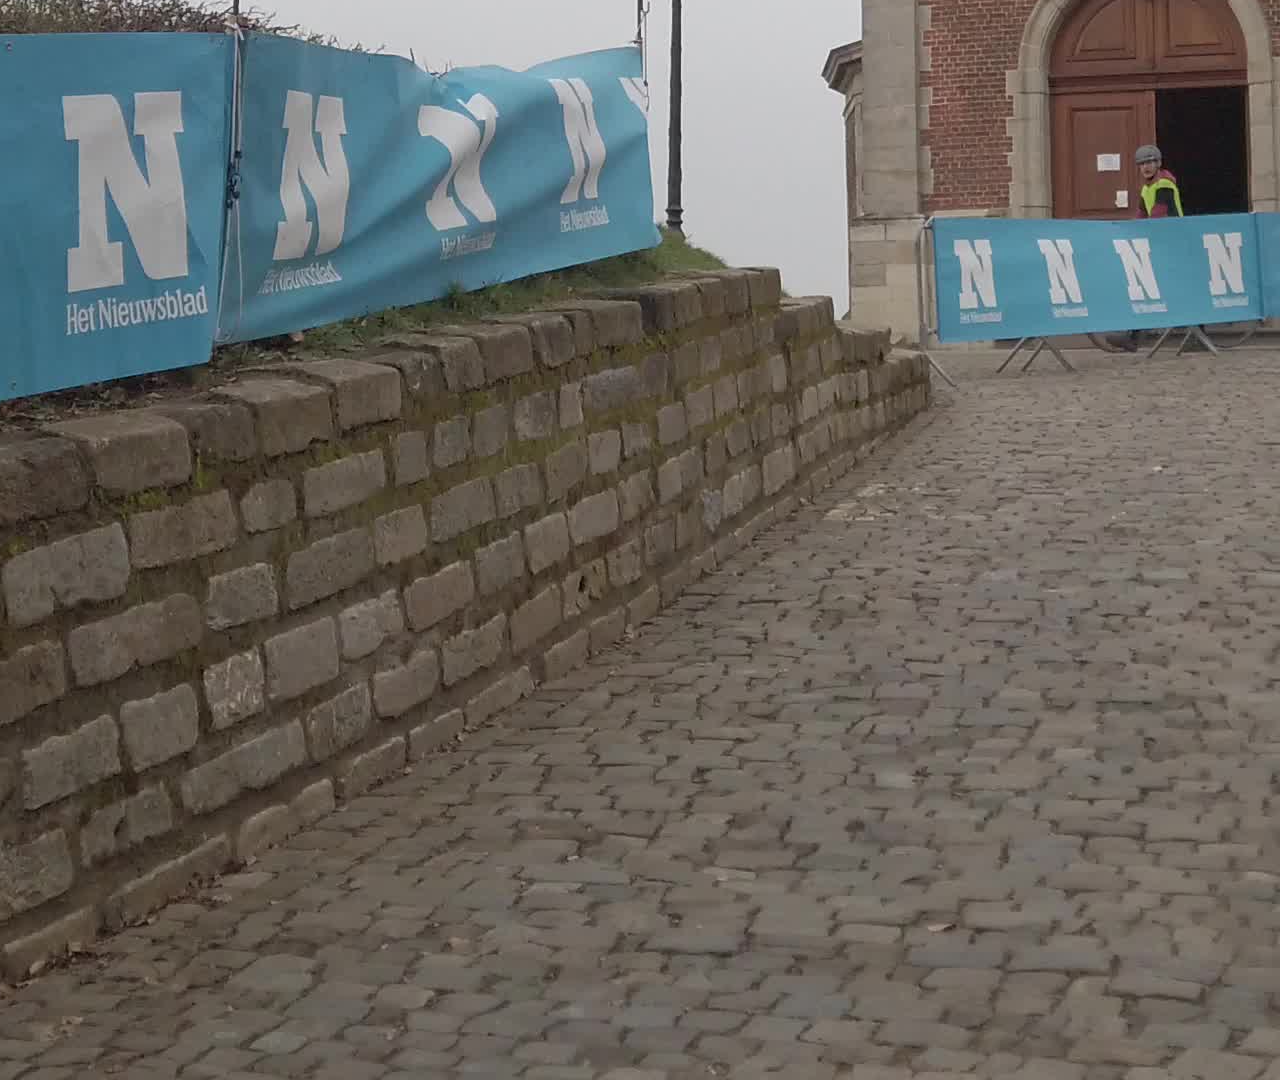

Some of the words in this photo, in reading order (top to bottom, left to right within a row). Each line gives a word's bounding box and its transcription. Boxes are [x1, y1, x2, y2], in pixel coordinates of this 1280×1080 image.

[548, 78, 606, 204] N
[61, 90, 188, 292] N
[273, 90, 349, 260] N
[953, 239, 997, 309] N
[1037, 239, 1083, 304] N
[1112, 238, 1160, 301] N
[1203, 232, 1245, 295] N
[66, 303, 96, 336] Het
[98, 285, 208, 330] Nieuwsblad
